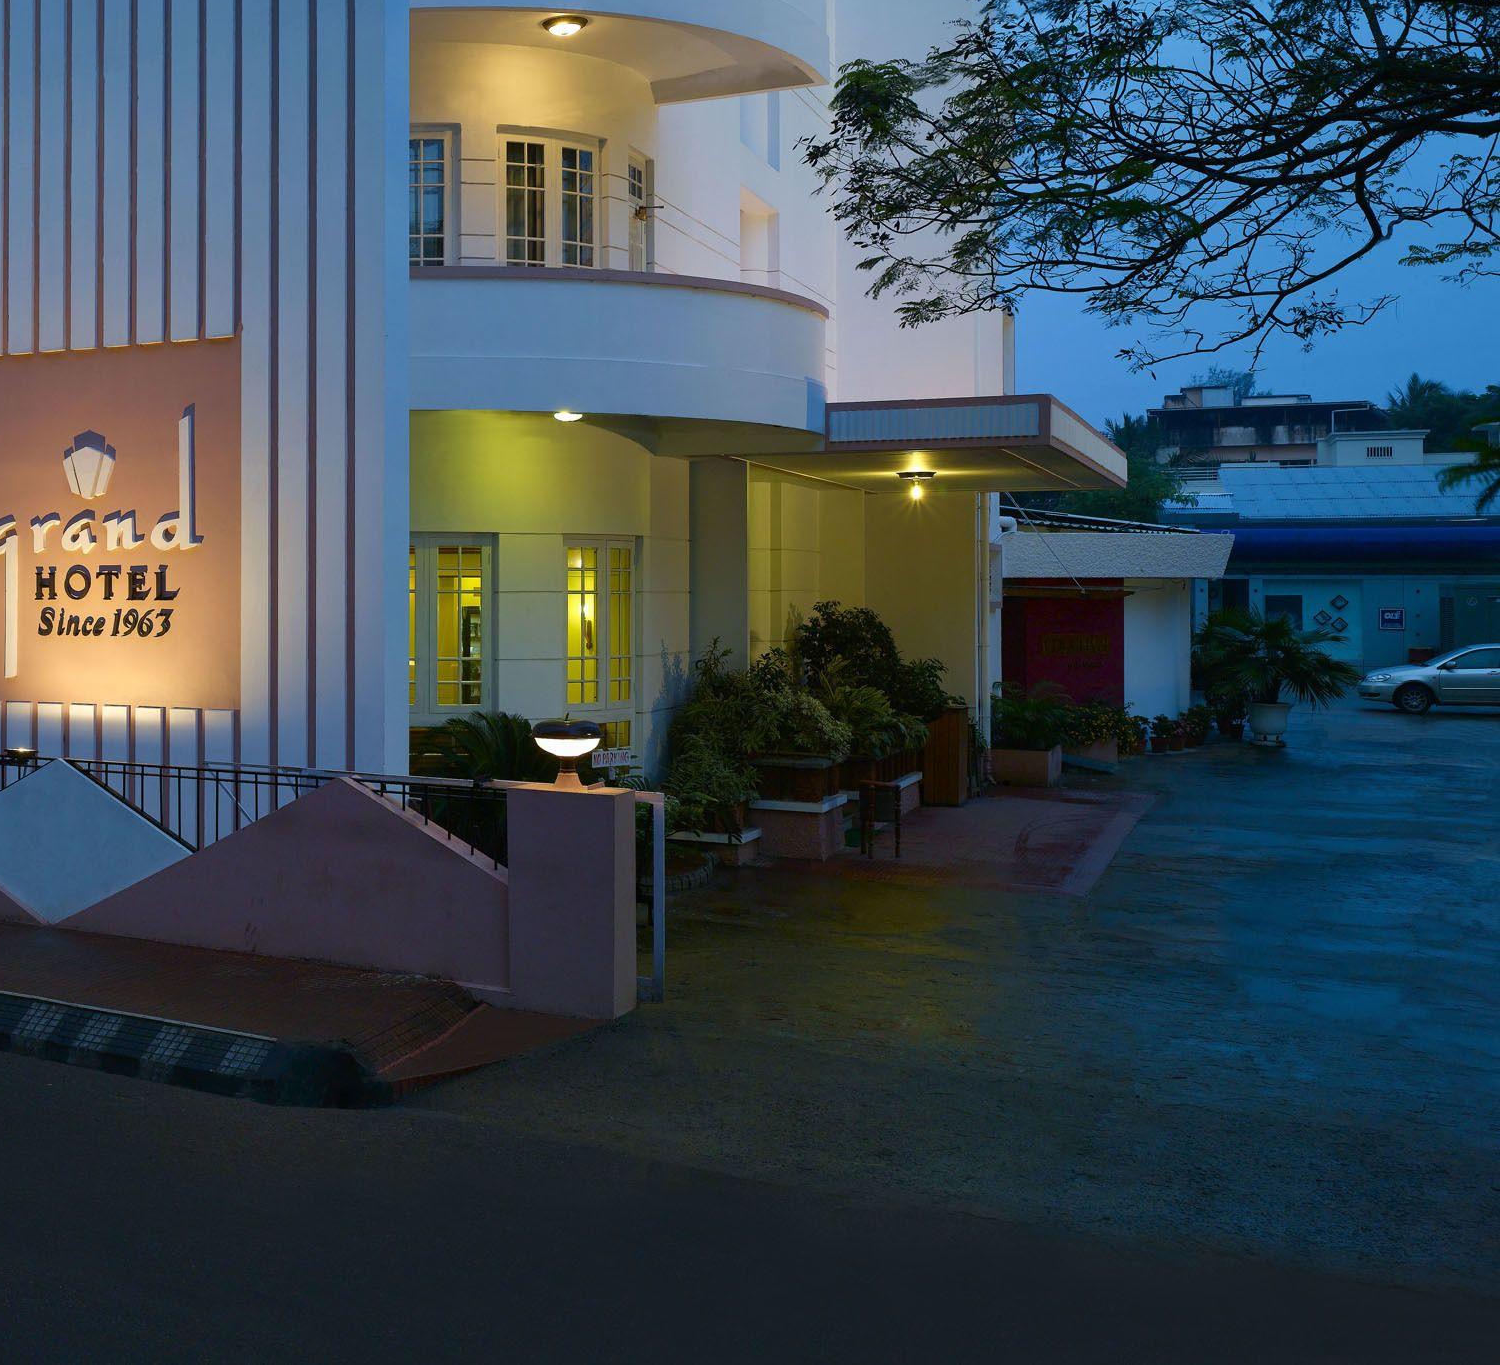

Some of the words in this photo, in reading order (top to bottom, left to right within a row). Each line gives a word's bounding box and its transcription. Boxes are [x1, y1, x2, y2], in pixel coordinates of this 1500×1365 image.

[34, 564, 181, 601] HOTEL
[37, 606, 105, 637] Since
[111, 608, 174, 638] 1963
[593, 752, 602, 764] NO
[603, 750, 629, 765] PARKING
